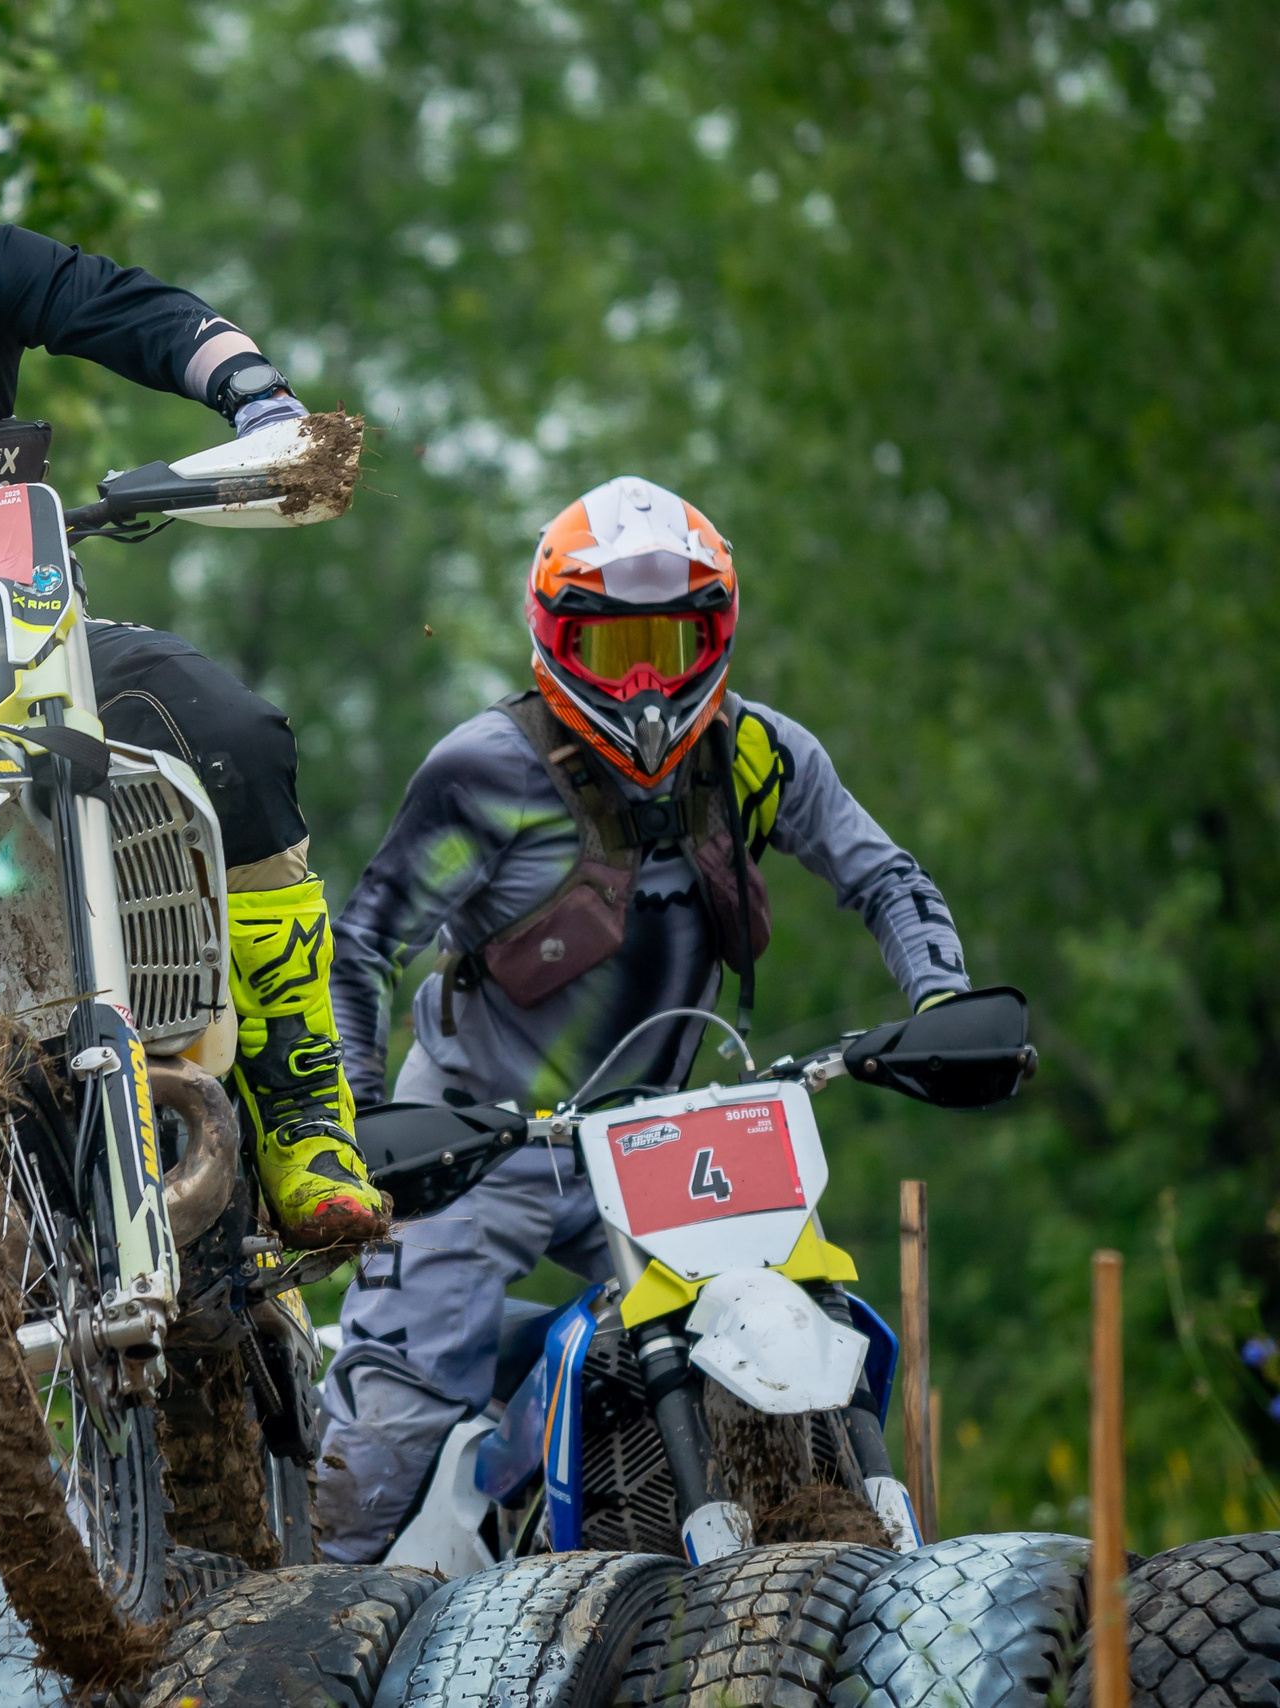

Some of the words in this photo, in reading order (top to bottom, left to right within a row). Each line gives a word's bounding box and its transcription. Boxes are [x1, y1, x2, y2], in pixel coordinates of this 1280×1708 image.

[128, 1038, 159, 1183] MANNOL
[725, 1107, 770, 1121] ЗОЛОТО
[688, 1147, 733, 1202] 4
